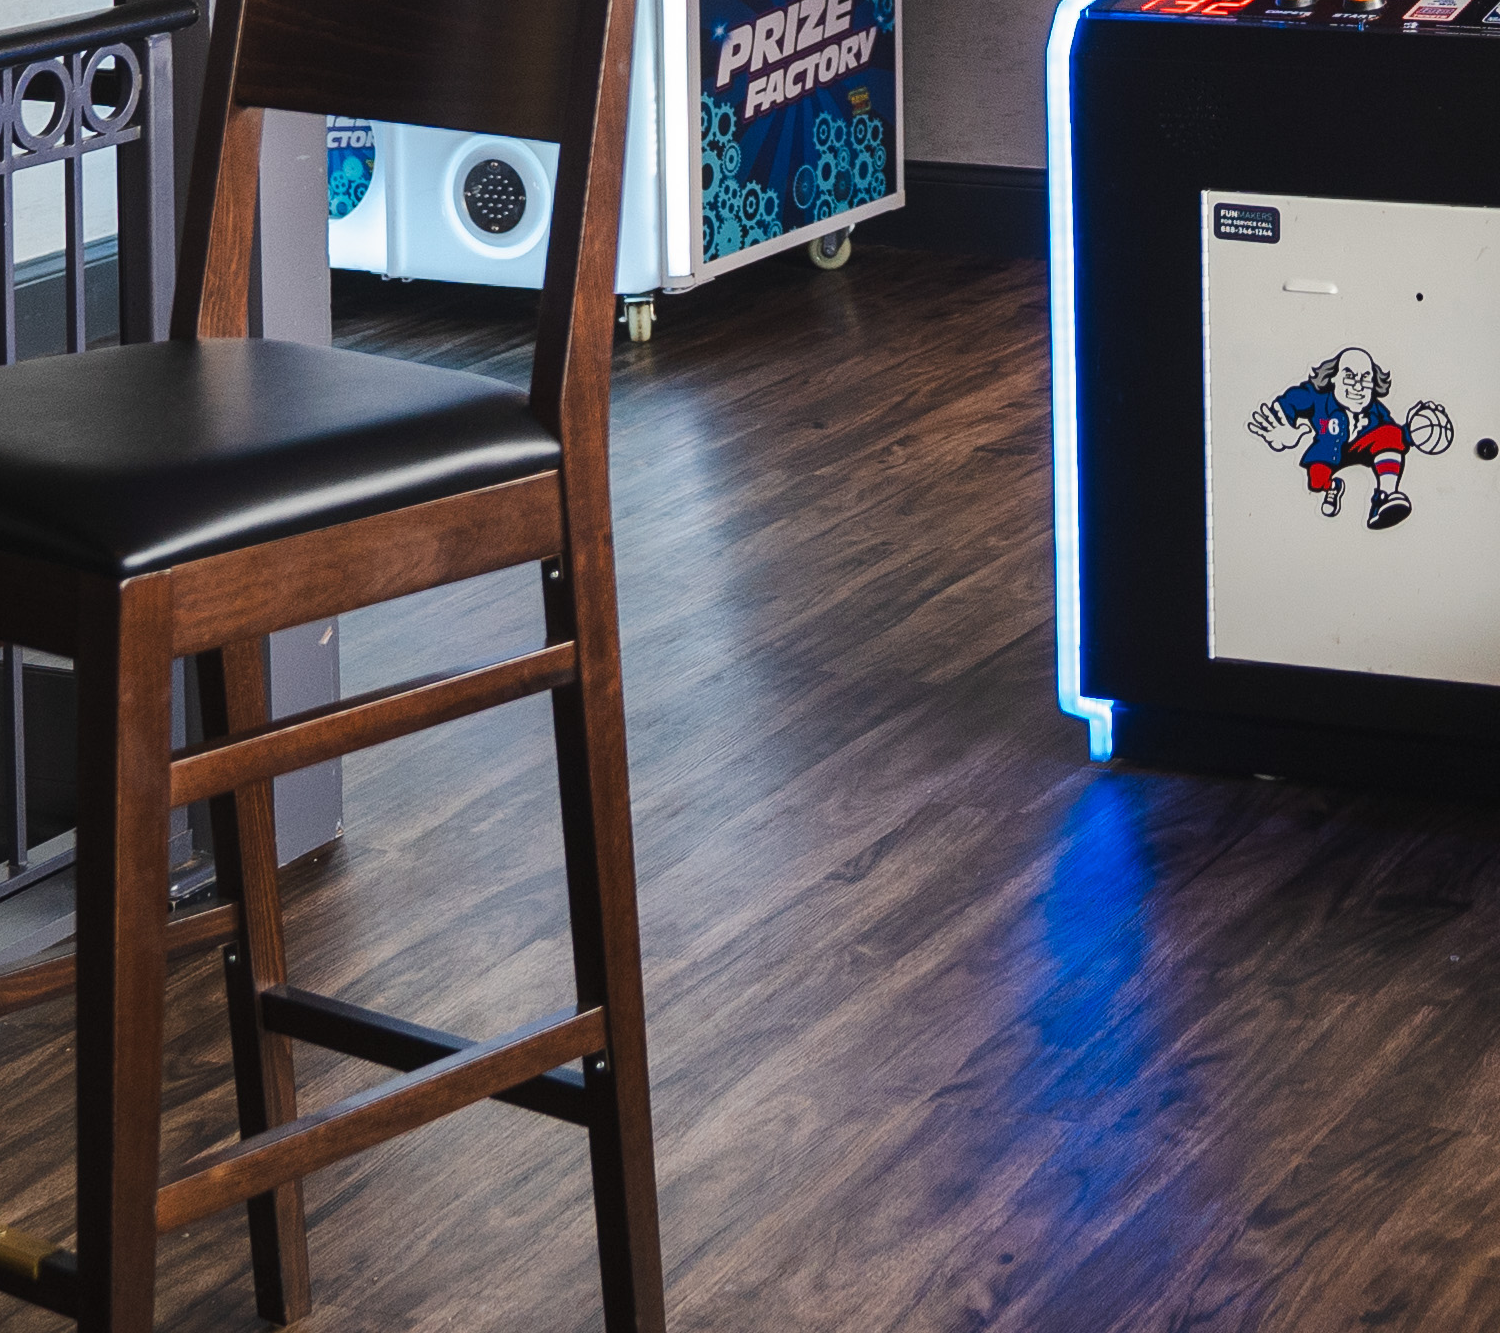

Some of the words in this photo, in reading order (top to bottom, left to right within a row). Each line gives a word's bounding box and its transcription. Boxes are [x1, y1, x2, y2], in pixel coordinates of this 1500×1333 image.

[743, 26, 877, 119] FACTORY
[1233, 219, 1257, 227] SERVICE
[1257, 221, 1273, 229] CALL
[1319, 418, 1340, 435] 76
